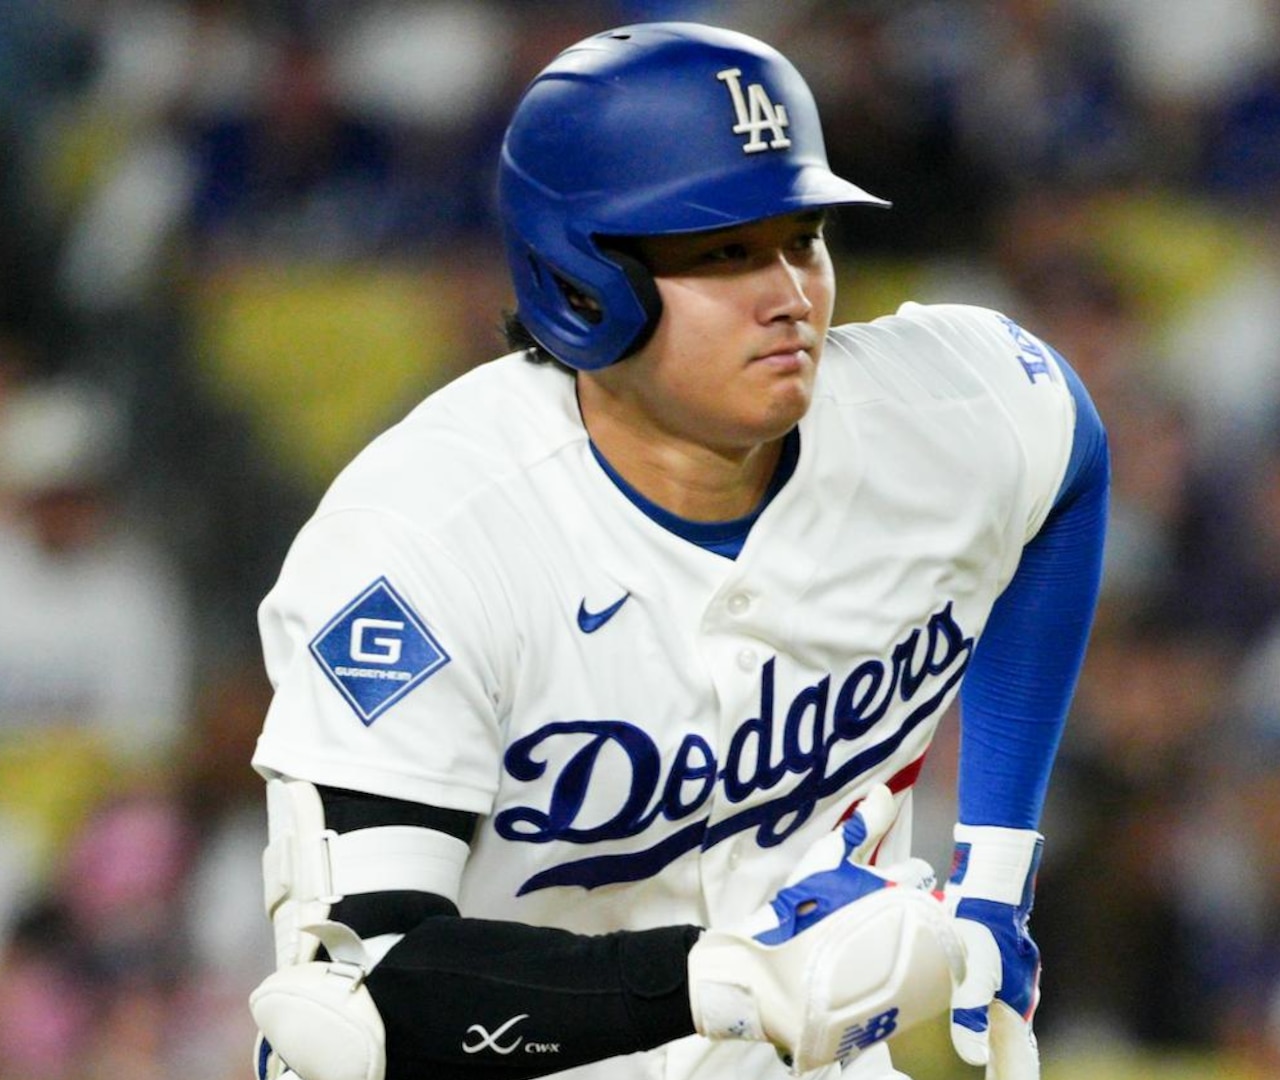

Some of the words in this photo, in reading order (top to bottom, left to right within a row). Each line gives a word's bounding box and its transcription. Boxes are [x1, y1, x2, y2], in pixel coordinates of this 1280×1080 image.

[717, 68, 791, 153] LA
[350, 617, 405, 664] G
[494, 600, 974, 850] Dodgers
